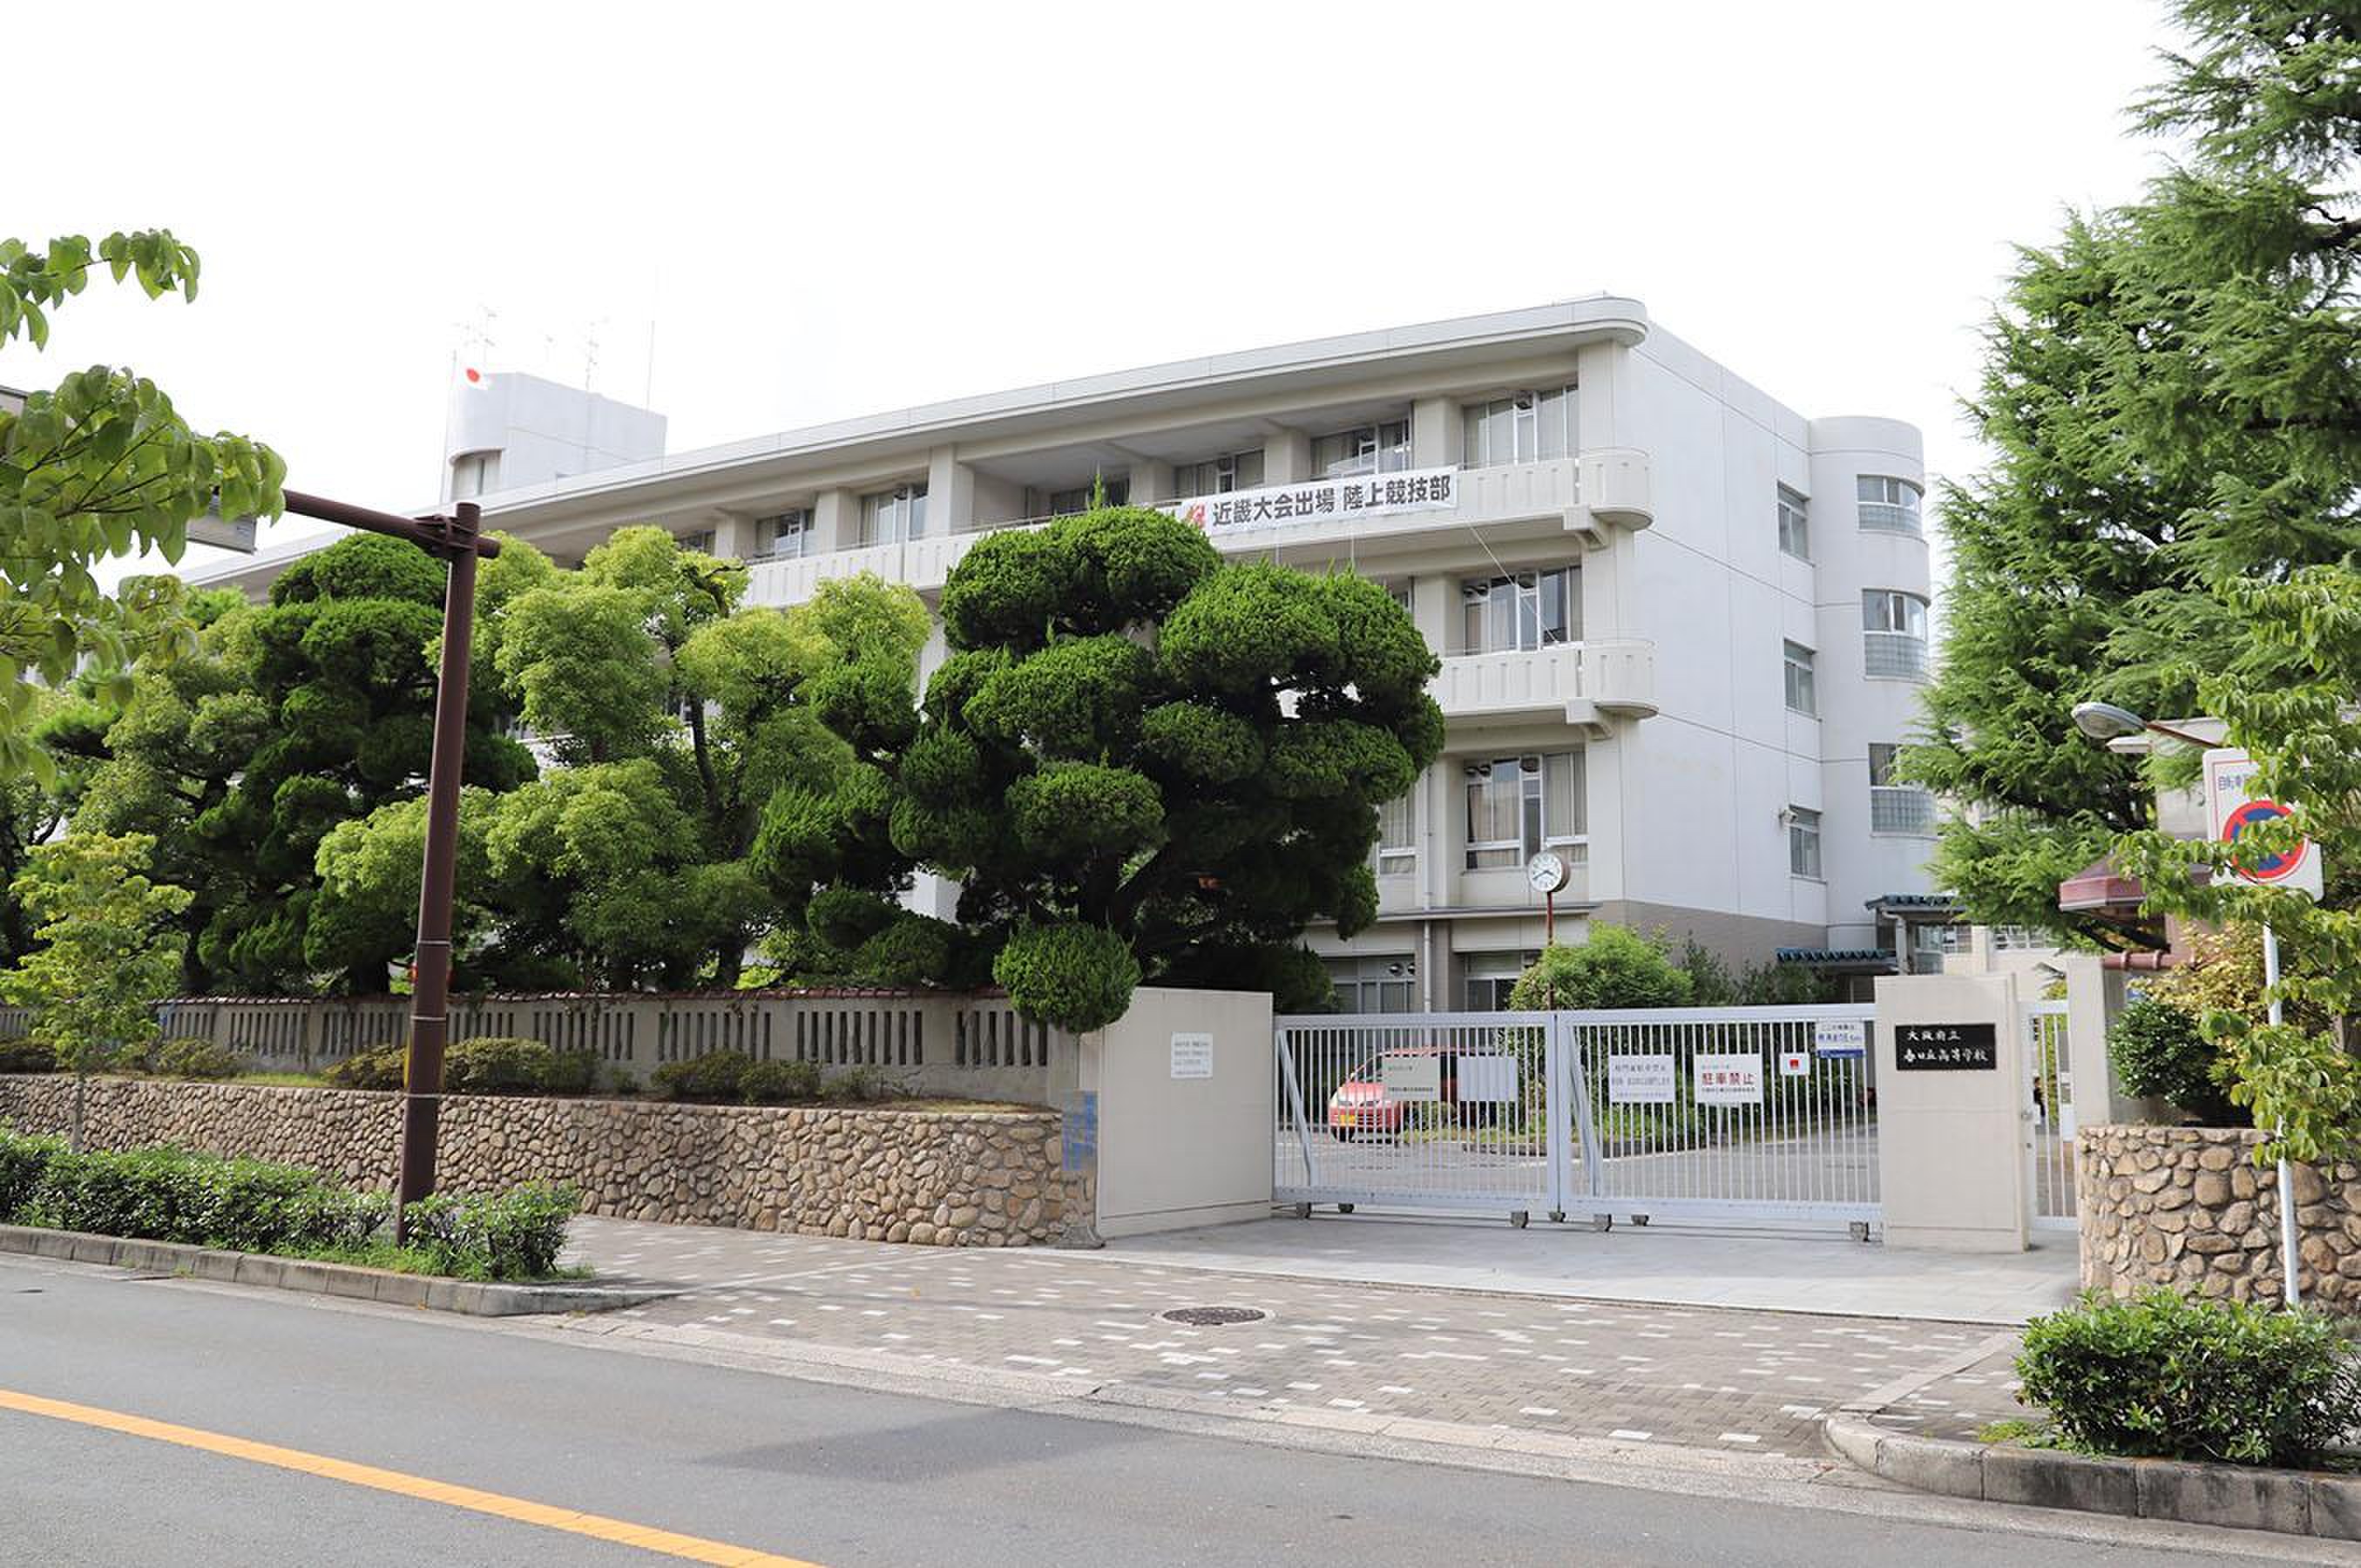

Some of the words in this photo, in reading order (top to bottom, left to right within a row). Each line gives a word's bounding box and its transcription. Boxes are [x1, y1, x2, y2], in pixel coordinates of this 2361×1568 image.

[1213, 487, 1335, 526] 近畿大会出場
[1343, 475, 1451, 511] 陸上競技部
[1906, 1031, 1961, 1042] 大阪府立
[1701, 1072, 1756, 1086] 駐車禁止
